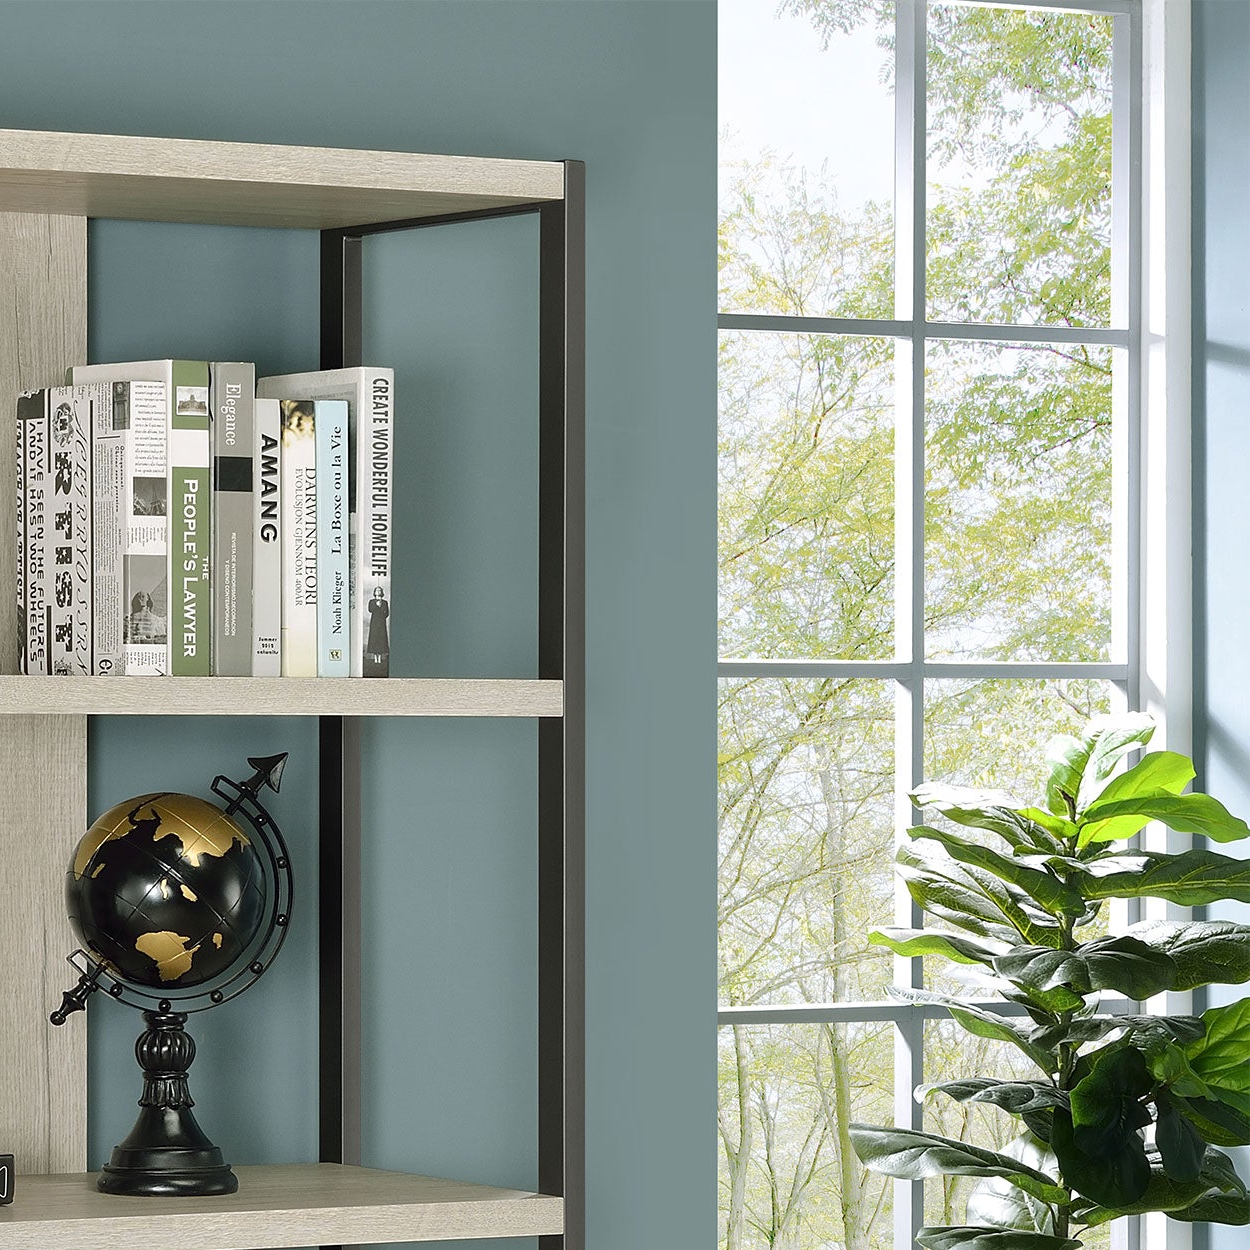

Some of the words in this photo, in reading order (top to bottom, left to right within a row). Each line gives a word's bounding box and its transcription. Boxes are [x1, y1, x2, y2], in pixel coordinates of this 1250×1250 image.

[221, 383, 241, 446] Elegance
[372, 378, 389, 424] CREATE
[332, 426, 342, 450] Vie
[332, 455, 342, 468] la
[30, 467, 37, 480] IT
[261, 434, 278, 544] AMANG
[334, 472, 342, 491] ou
[372, 429, 389, 508] WONDERFUL
[294, 468, 303, 525] EVOLUSJON
[305, 467, 317, 548] DARWINS
[332, 494, 342, 531] Boxe
[183, 479, 198, 571] PEOPLE'S
[332, 536, 342, 554] La
[372, 513, 388, 577] HOMELIFE
[294, 528, 303, 576] GJENNOM
[305, 554, 317, 606] TEORI
[332, 571, 344, 605] Klieger
[183, 577, 198, 657] LAWYER
[332, 608, 342, 634] Noah
